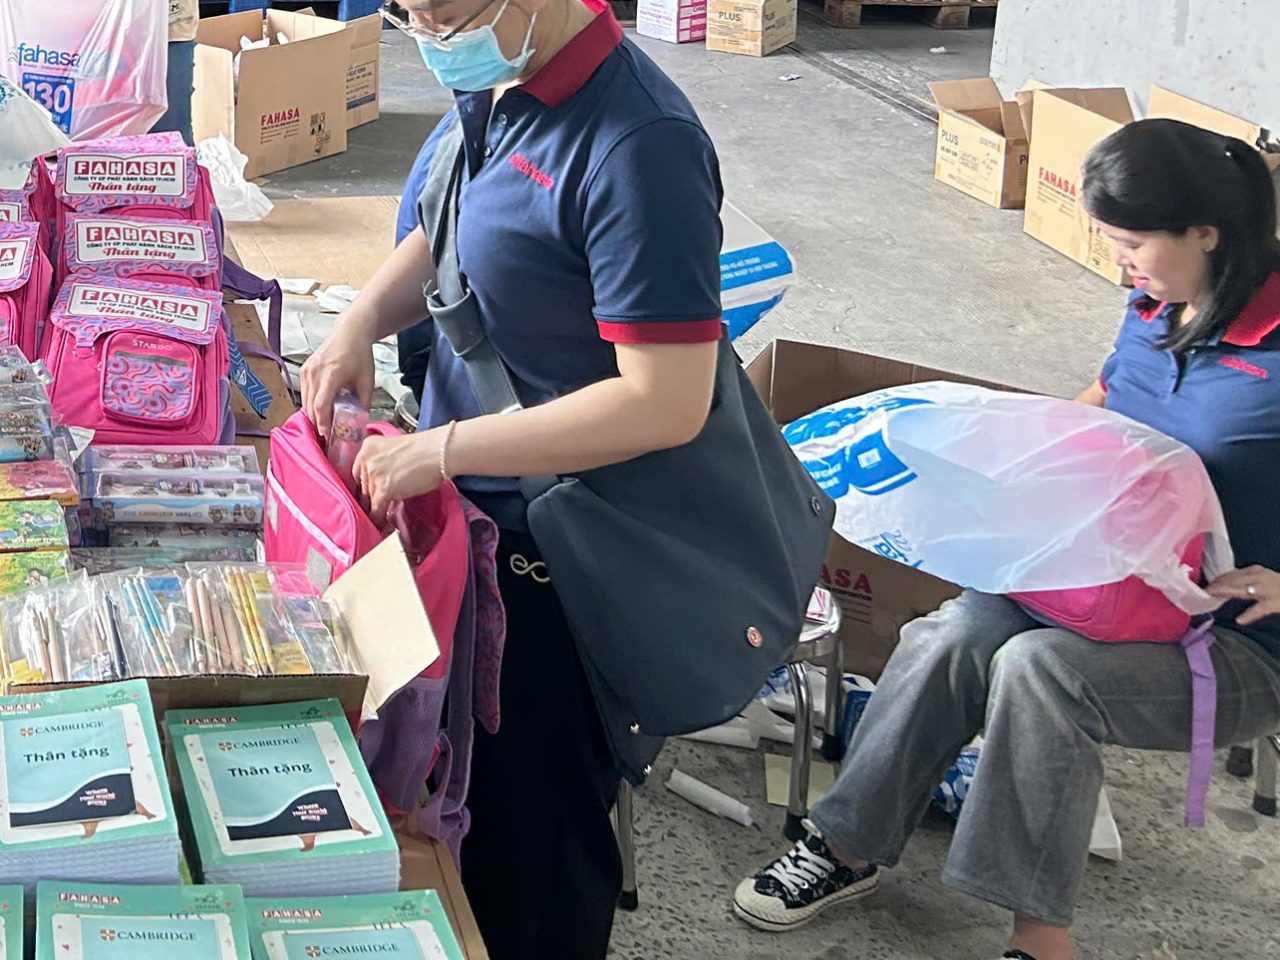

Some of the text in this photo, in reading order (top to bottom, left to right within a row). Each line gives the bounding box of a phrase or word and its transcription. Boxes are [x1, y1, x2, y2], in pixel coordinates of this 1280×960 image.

[718, 11, 741, 22] PLUS
[18, 43, 81, 67] fahasa
[260, 108, 300, 127] FAHASA
[941, 129, 959, 146] PLUS
[74, 161, 176, 176] FAHASA
[1039, 167, 1077, 198] FAHASA
[86, 226, 195, 246] FAHASA
[81, 289, 199, 318] FAHASA
[35, 721, 105, 735] CAMBRIDGE
[233, 738, 300, 750] CAMBRIDGE
[23, 747, 110, 764] Thân tặng
[227, 762, 313, 778] Thân tặng
[59, 892, 121, 905] FAHASA
[261, 908, 322, 919] FAHASA
[117, 930, 198, 941] CAMBRIDGE
[322, 943, 400, 955] CAMBRIDGE
